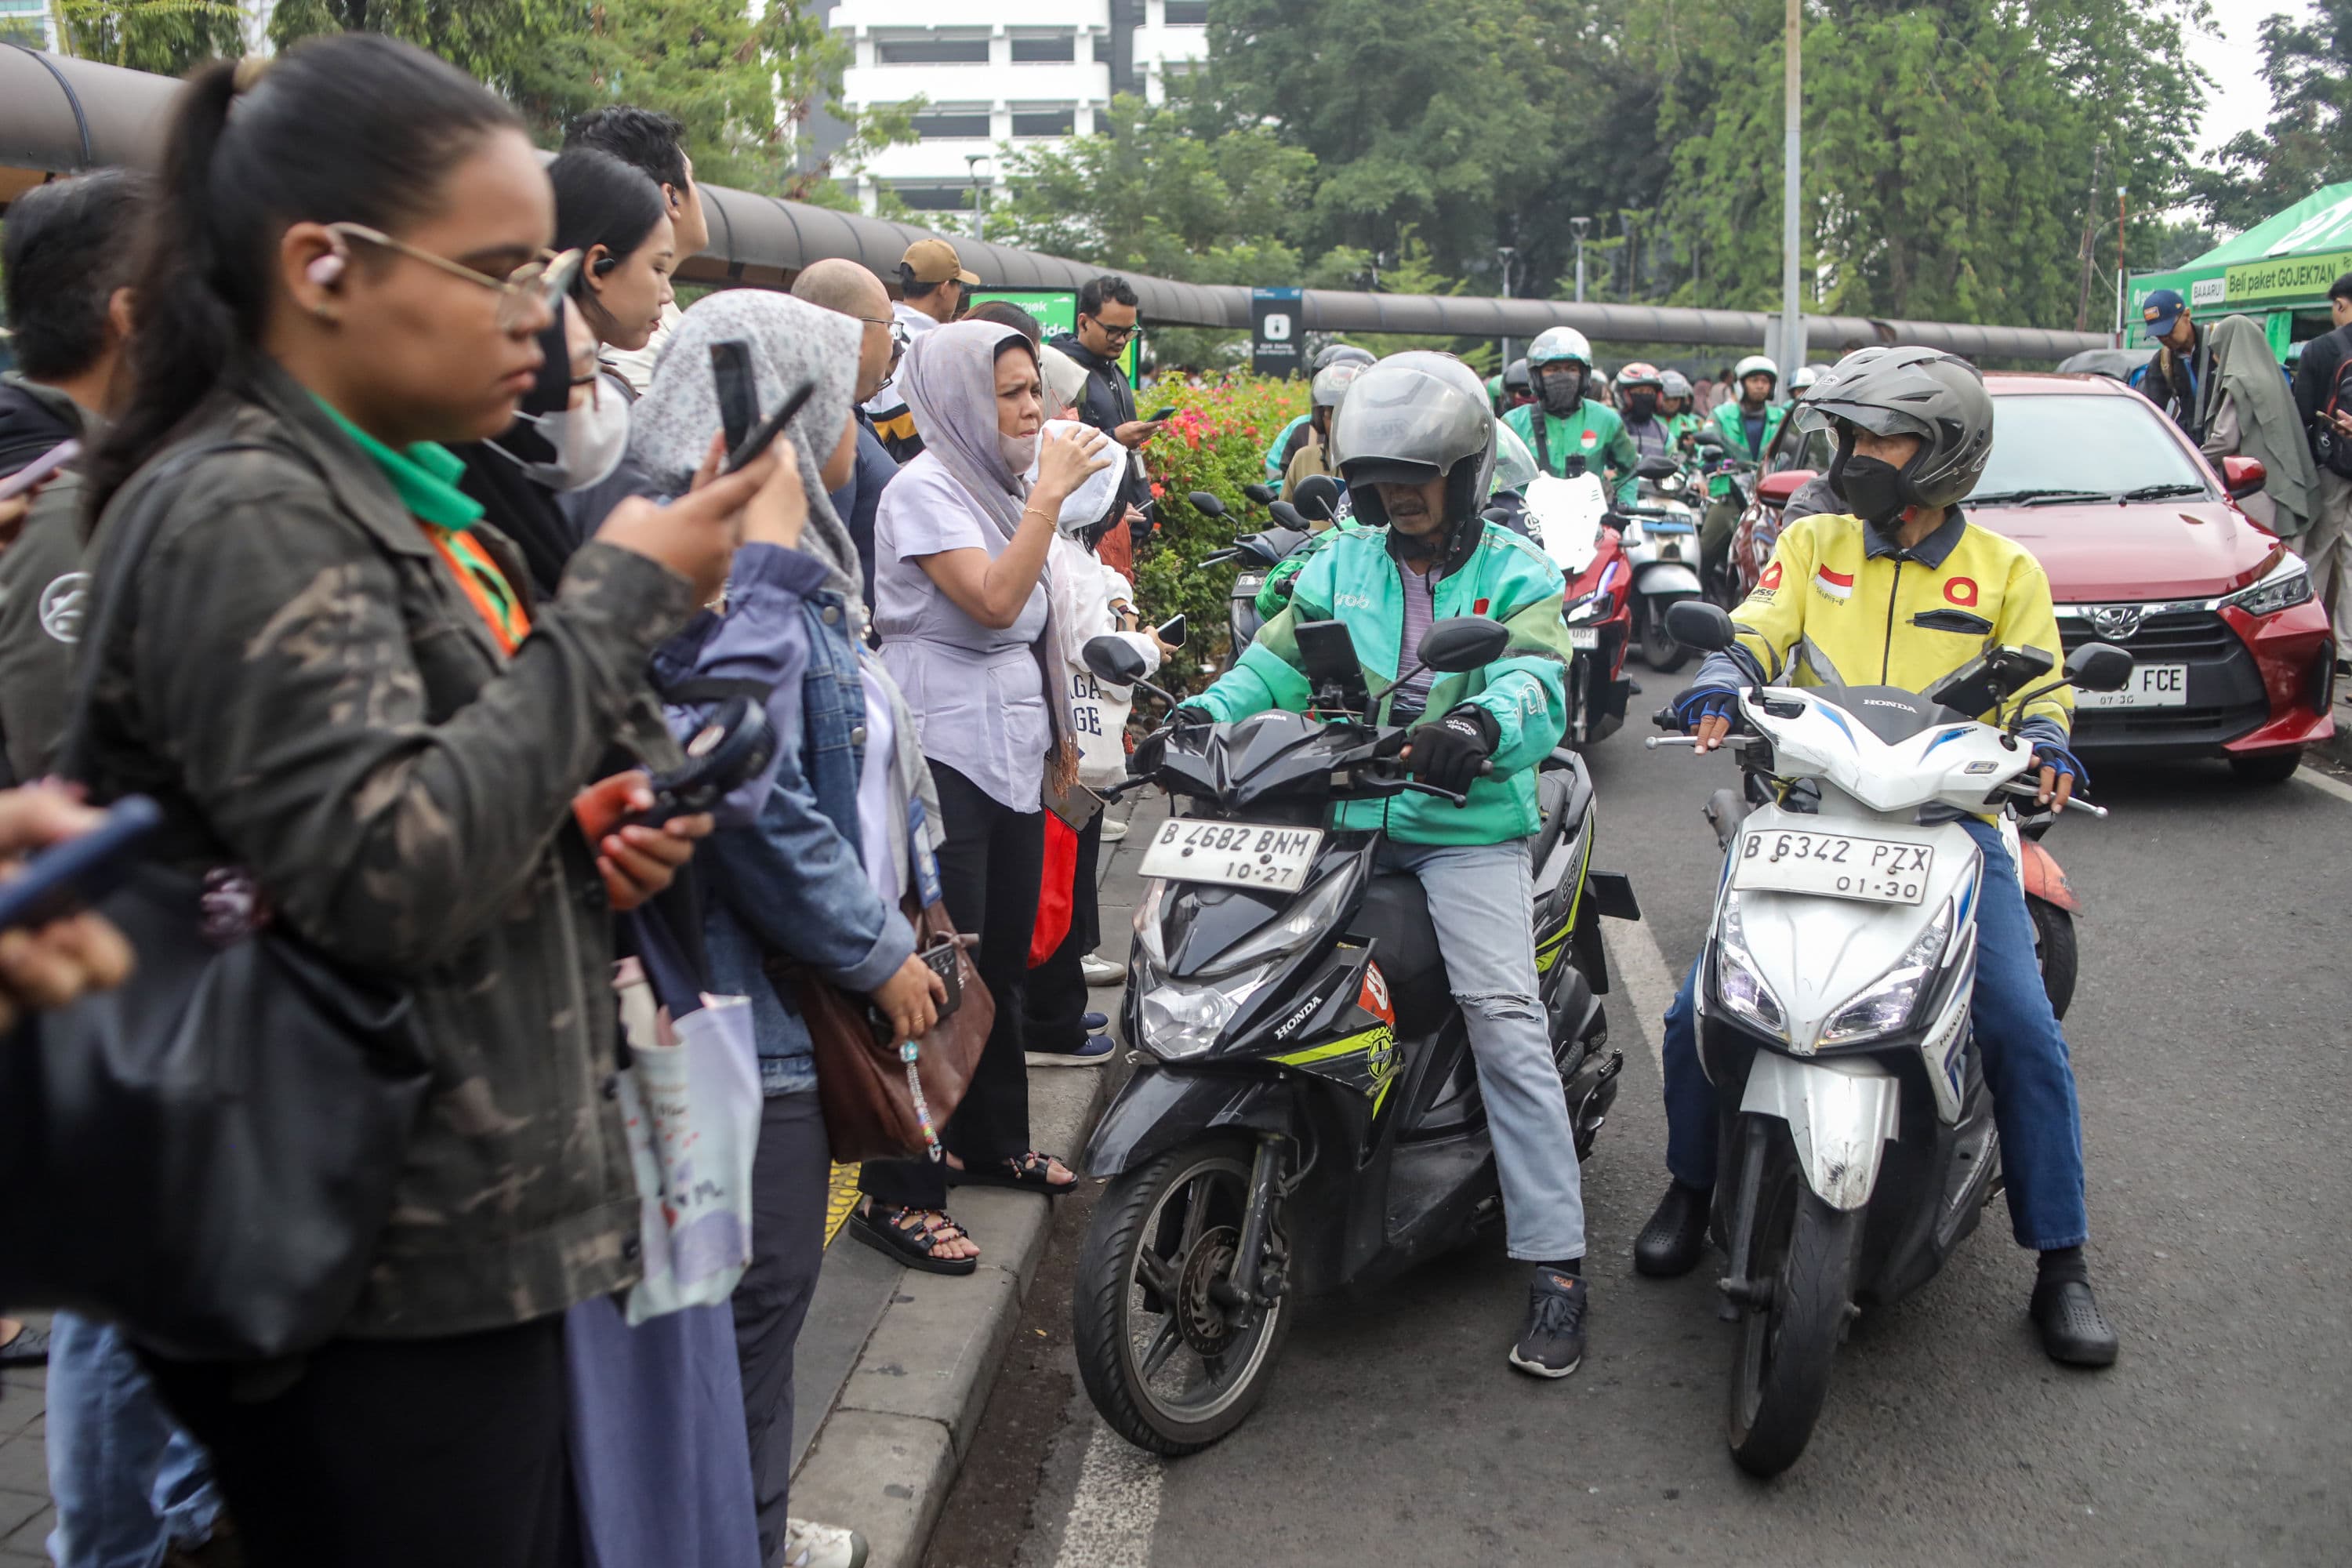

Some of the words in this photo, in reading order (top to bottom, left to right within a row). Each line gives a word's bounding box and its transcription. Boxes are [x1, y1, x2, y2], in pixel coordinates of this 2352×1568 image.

[2194, 284, 2223, 299] BAAARU!
[2229, 270, 2247, 293] Beli
[2249, 270, 2277, 296] paket
[2278, 263, 2337, 288] GOJEK7AN
[1017, 300, 1048, 314] ojek
[2143, 669, 2182, 691] FCE
[1862, 699, 1918, 714] HONDA
[1160, 822, 1179, 845] B
[1184, 825, 1251, 851] 4682
[1254, 829, 1311, 857] BNM
[1744, 835, 1762, 859] B
[1775, 834, 1850, 863] 6342
[1871, 844, 1928, 871] PZX
[1273, 995, 1323, 1041] HONDA
